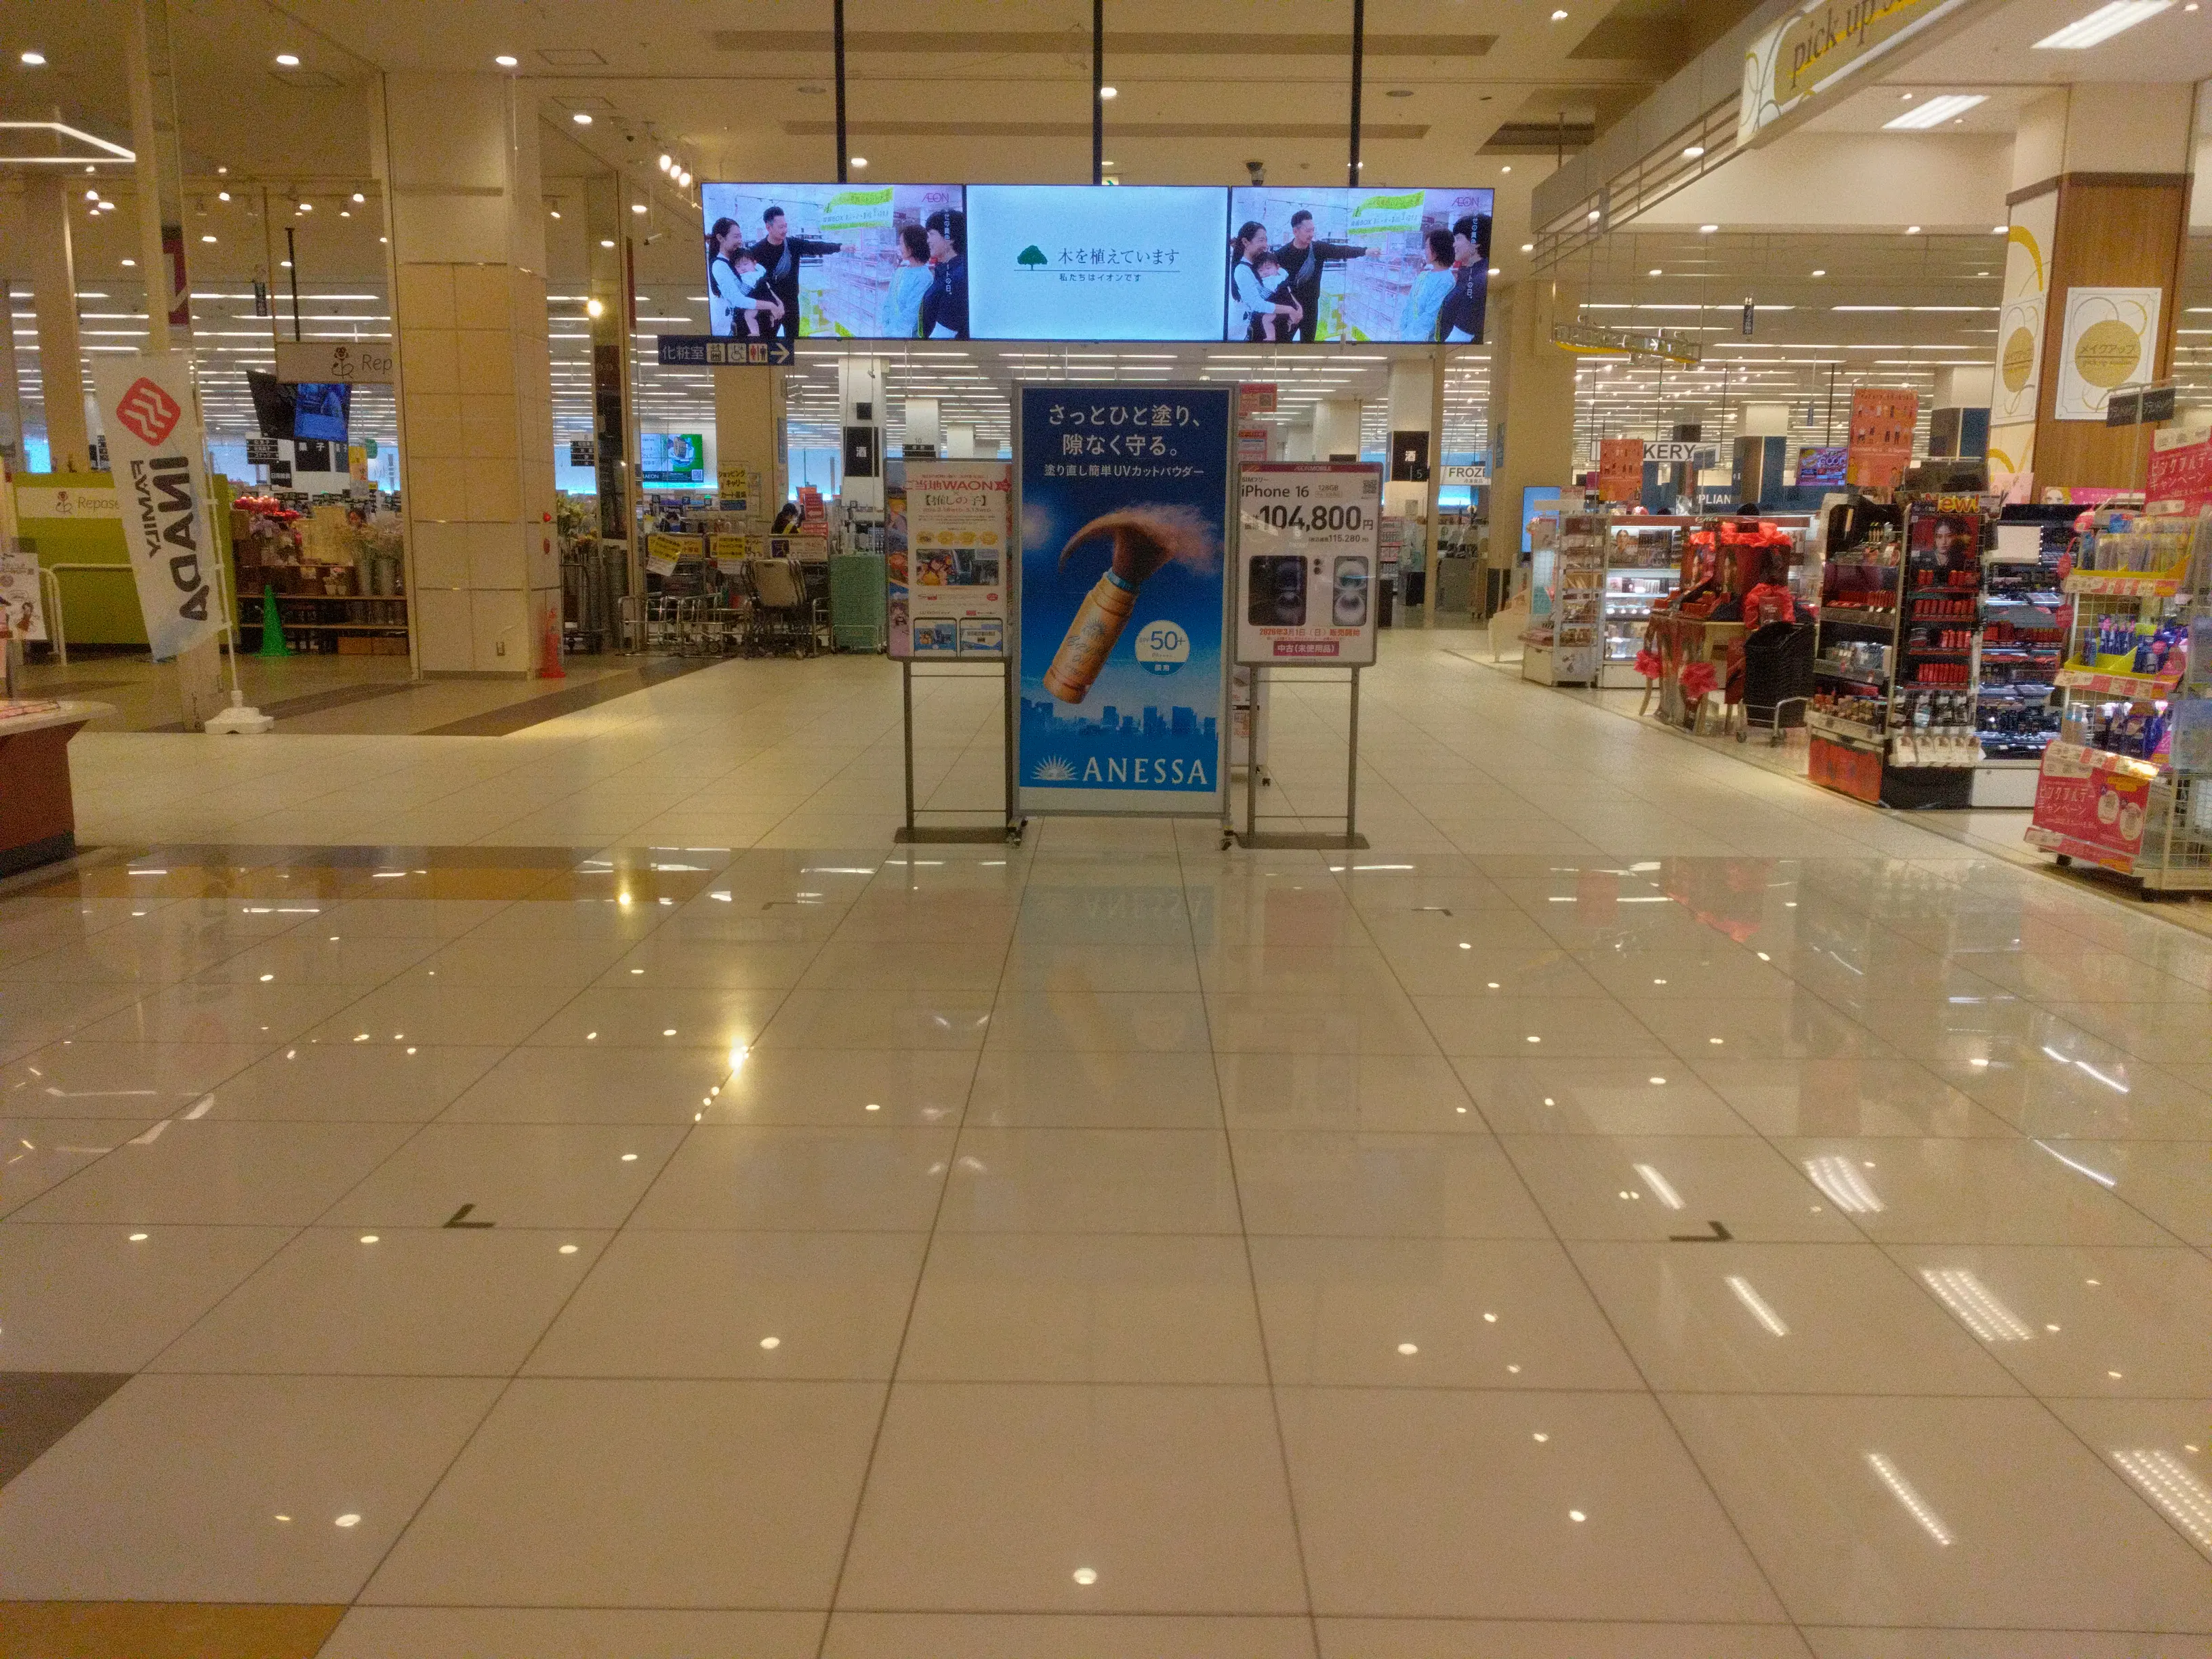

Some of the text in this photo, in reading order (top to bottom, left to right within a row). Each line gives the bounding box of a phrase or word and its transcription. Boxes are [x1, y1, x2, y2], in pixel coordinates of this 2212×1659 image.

[1791, 7, 1837, 89] pick
[1058, 247, 1179, 265] 木を植えています
[1059, 273, 1141, 281] 私たちはイオンです
[663, 345, 704, 360] 化粧室
[1049, 404, 1200, 427] さっとひと塗り、
[1063, 434, 1176, 456] 隙なく守る。
[1643, 445, 1696, 459] KERY
[1405, 451, 1416, 462] 酒
[1241, 485, 1290, 497] iPhone
[1295, 485, 1309, 497] 16
[1082, 756, 1208, 784] ANESSA
